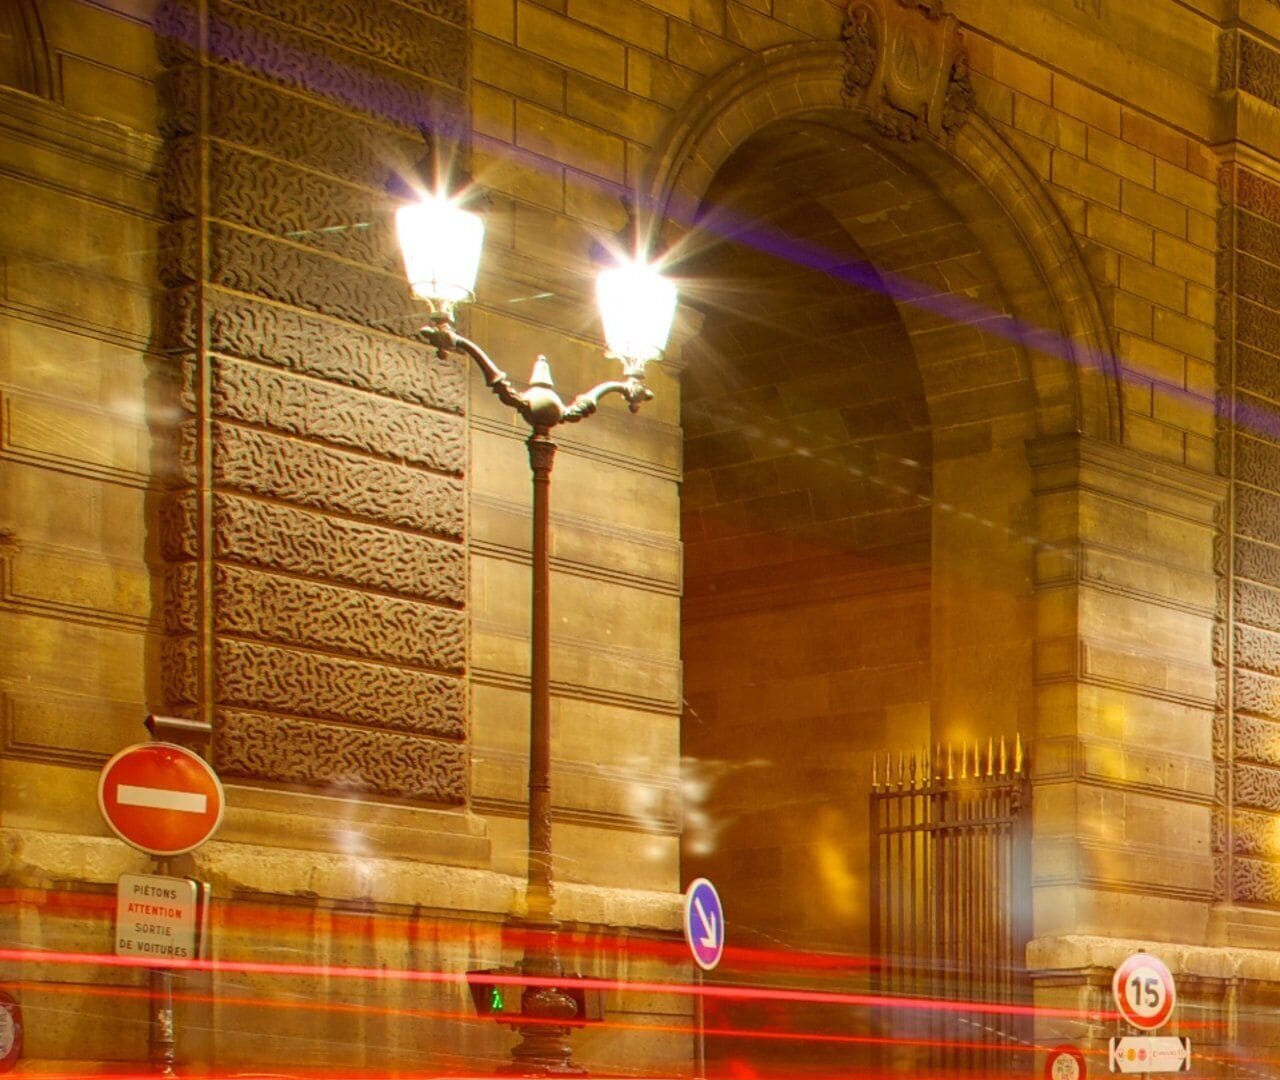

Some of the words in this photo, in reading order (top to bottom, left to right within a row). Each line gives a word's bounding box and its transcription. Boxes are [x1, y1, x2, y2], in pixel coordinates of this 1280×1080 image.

[133, 884, 177, 900] PIÉTONS
[128, 902, 182, 919] ATTENTION
[135, 922, 172, 937] SORTIE
[119, 939, 133, 950] DE
[136, 941, 188, 958] VOITURES
[1131, 976, 1160, 1008] 15
